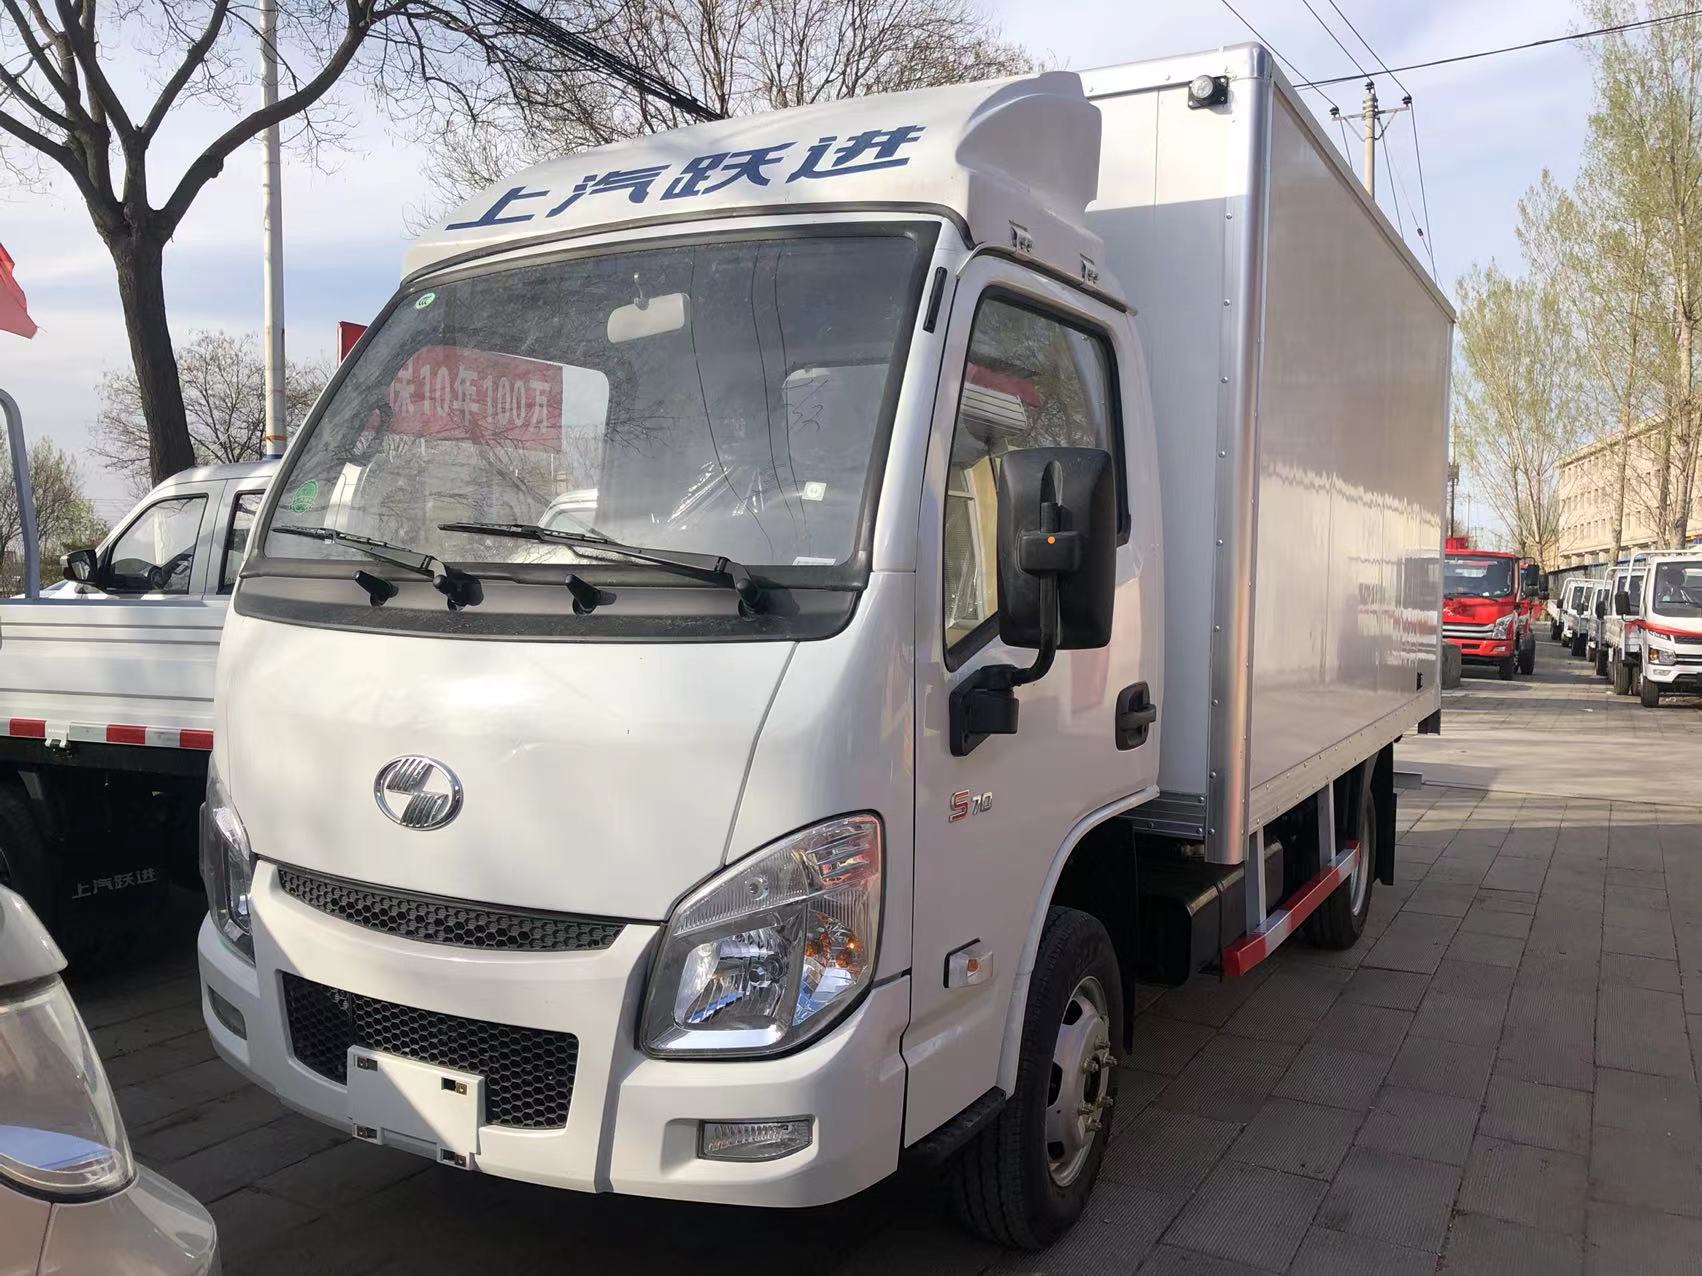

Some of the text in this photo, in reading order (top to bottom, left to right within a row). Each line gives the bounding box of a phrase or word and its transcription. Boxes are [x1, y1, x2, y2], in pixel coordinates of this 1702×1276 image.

[445, 125, 926, 231] 上汽跃进
[71, 867, 157, 899] 上汽跃进
